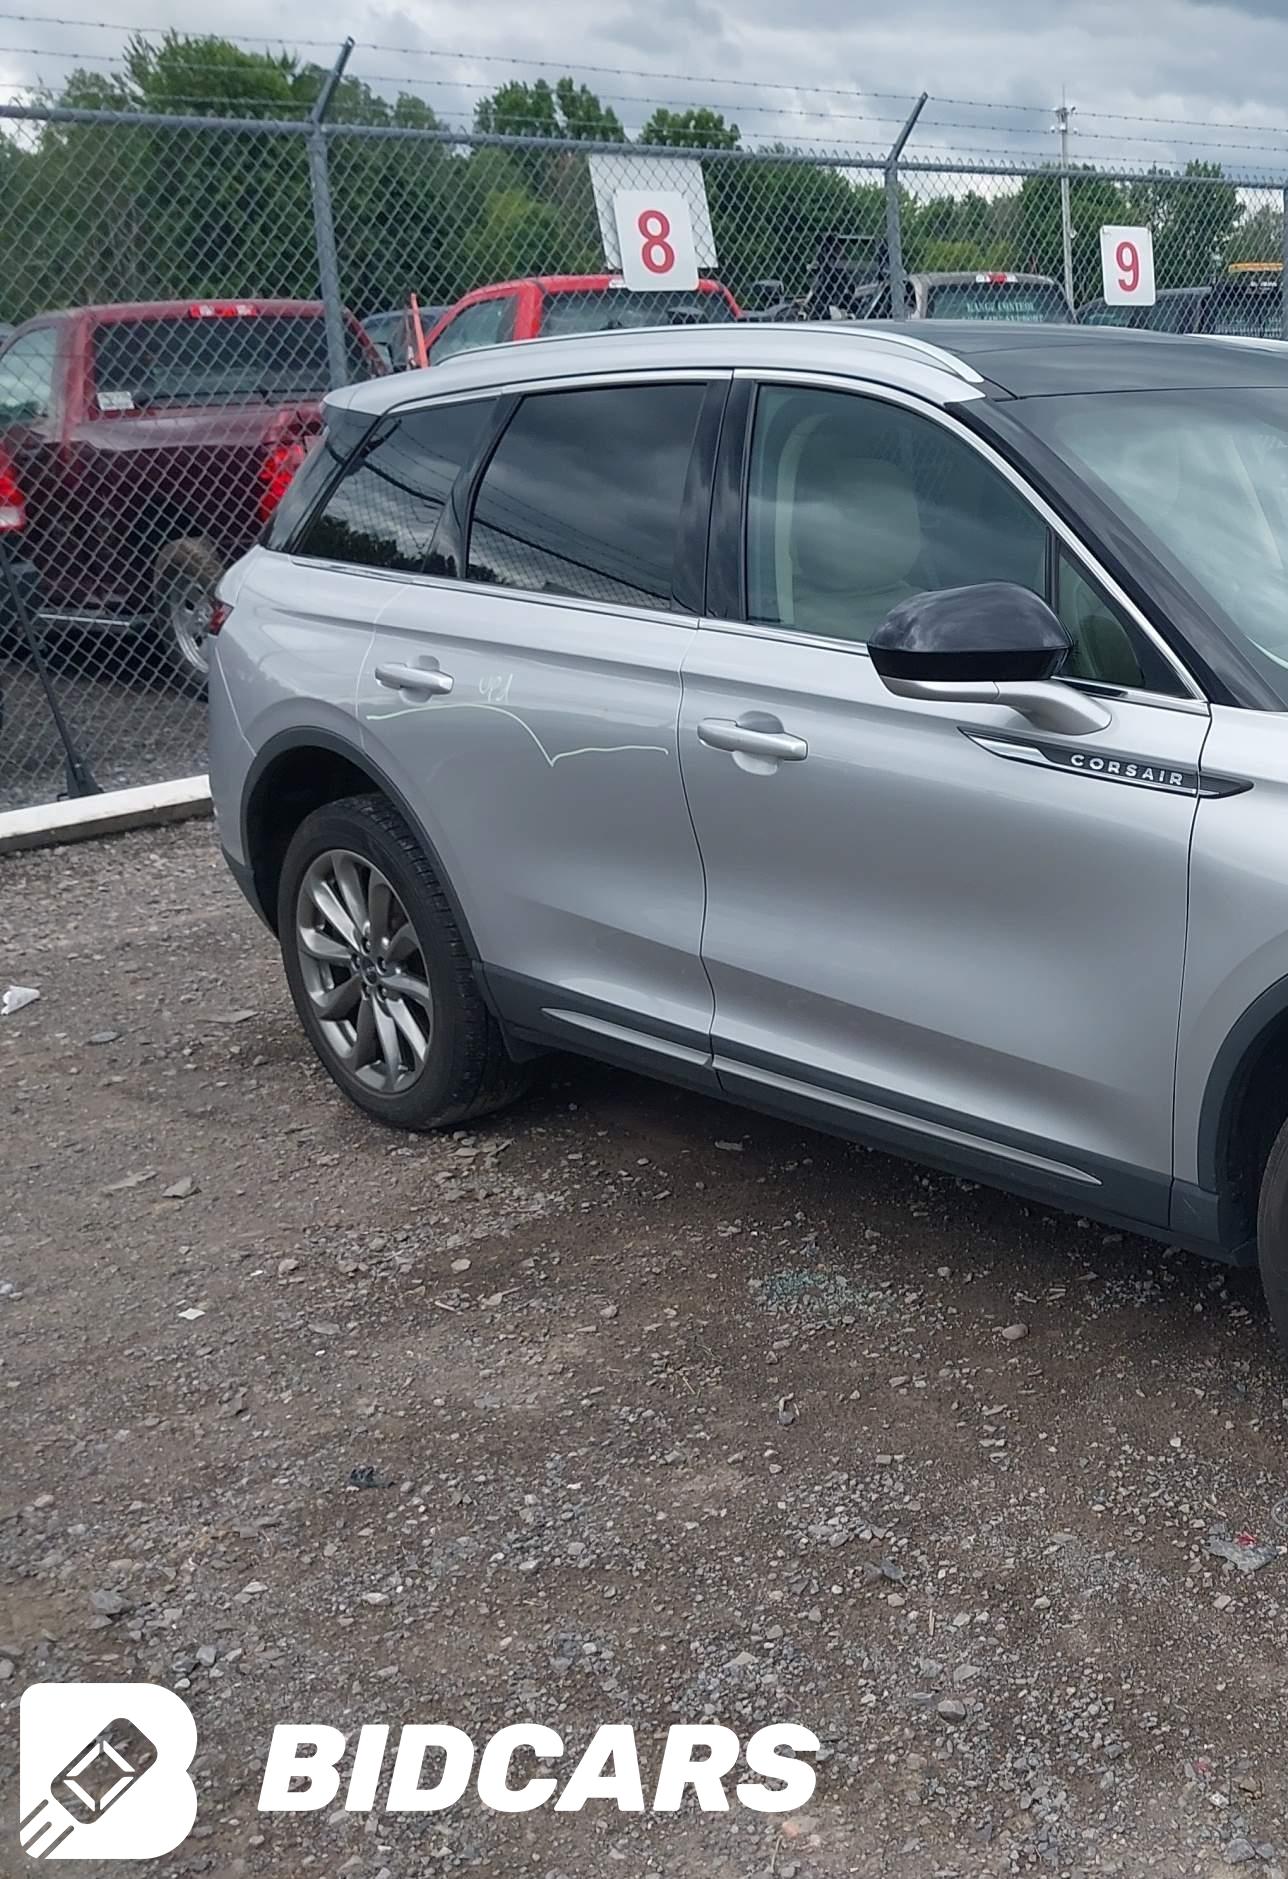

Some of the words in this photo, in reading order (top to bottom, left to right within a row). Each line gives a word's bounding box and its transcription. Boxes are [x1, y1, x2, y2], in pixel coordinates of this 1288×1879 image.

[638, 210, 675, 274] 8
[1116, 241, 1139, 292] 9
[1071, 754, 1183, 786] CORSAIR
